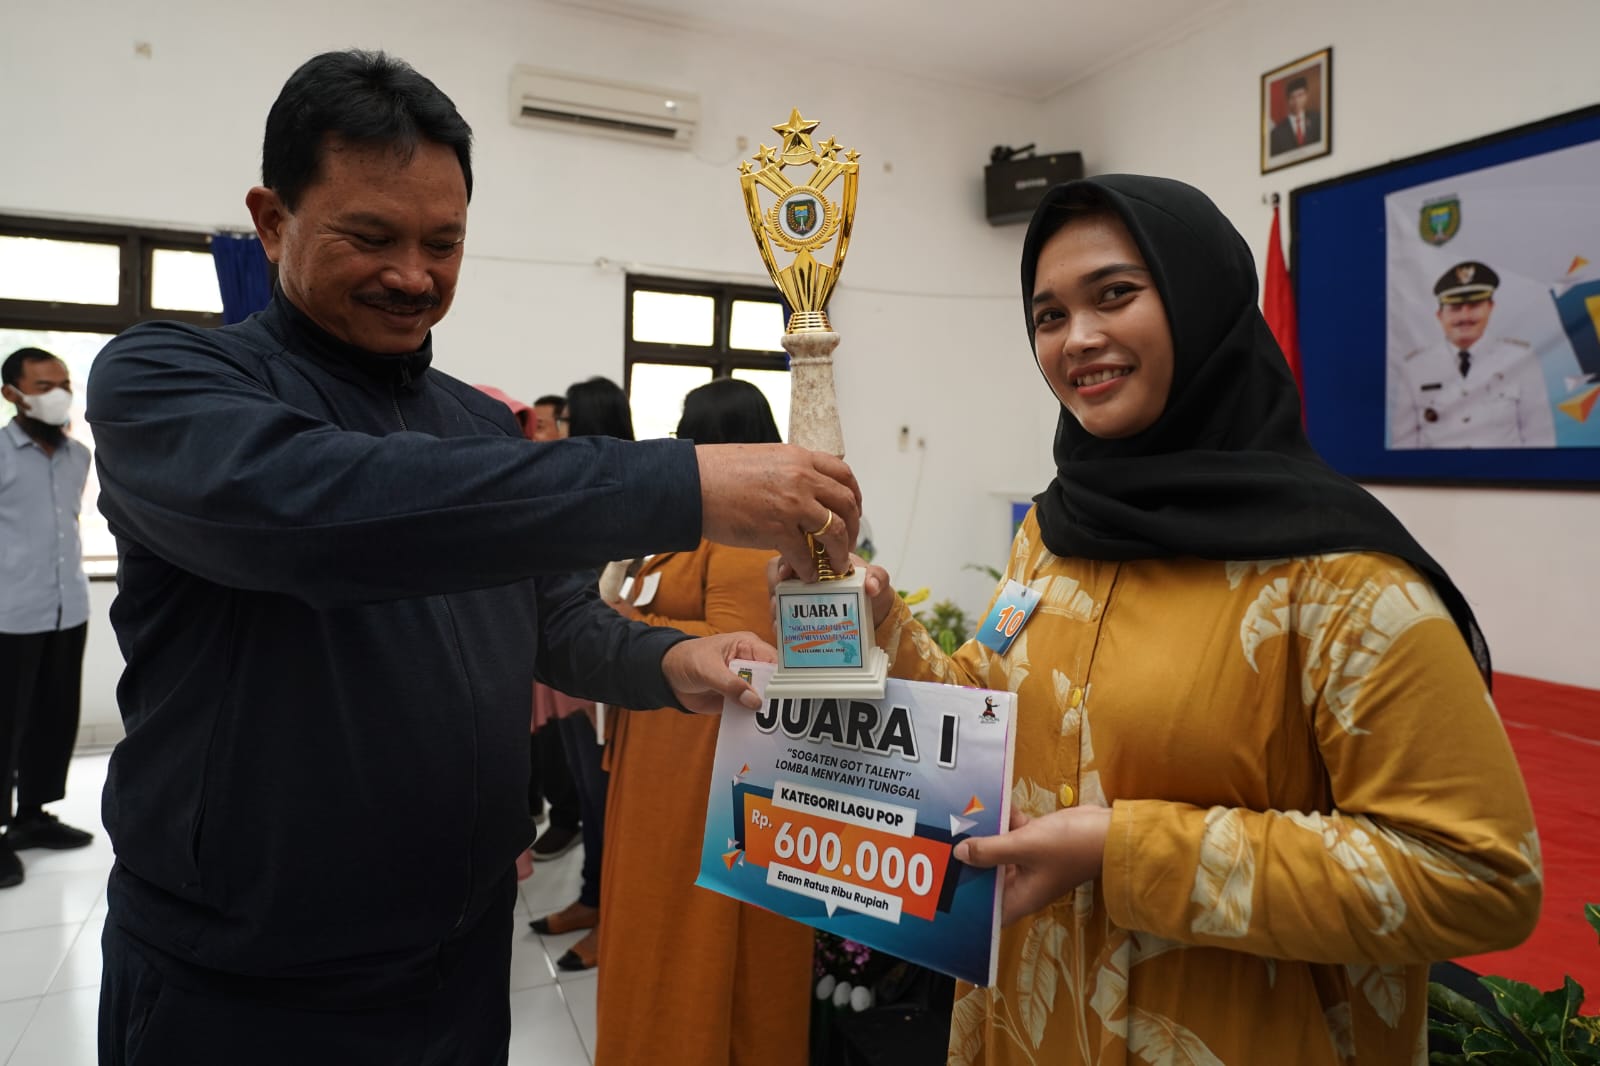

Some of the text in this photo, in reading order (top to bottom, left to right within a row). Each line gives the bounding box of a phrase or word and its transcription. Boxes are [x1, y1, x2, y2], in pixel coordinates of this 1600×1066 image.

[792, 604, 848, 618] JUARA I
[995, 605, 1025, 637] 10
[754, 698, 959, 767] JUARA I
[776, 760, 921, 800] LOMBA MENYANYI TUNGGAL
[840, 759, 863, 773] GOT
[751, 808, 773, 830] Rp.
[781, 787, 904, 827] KATEGORI LAGU POP
[774, 822, 933, 896] 600.000
[777, 870, 889, 911] Enam Ratus Ribu Rupiah
